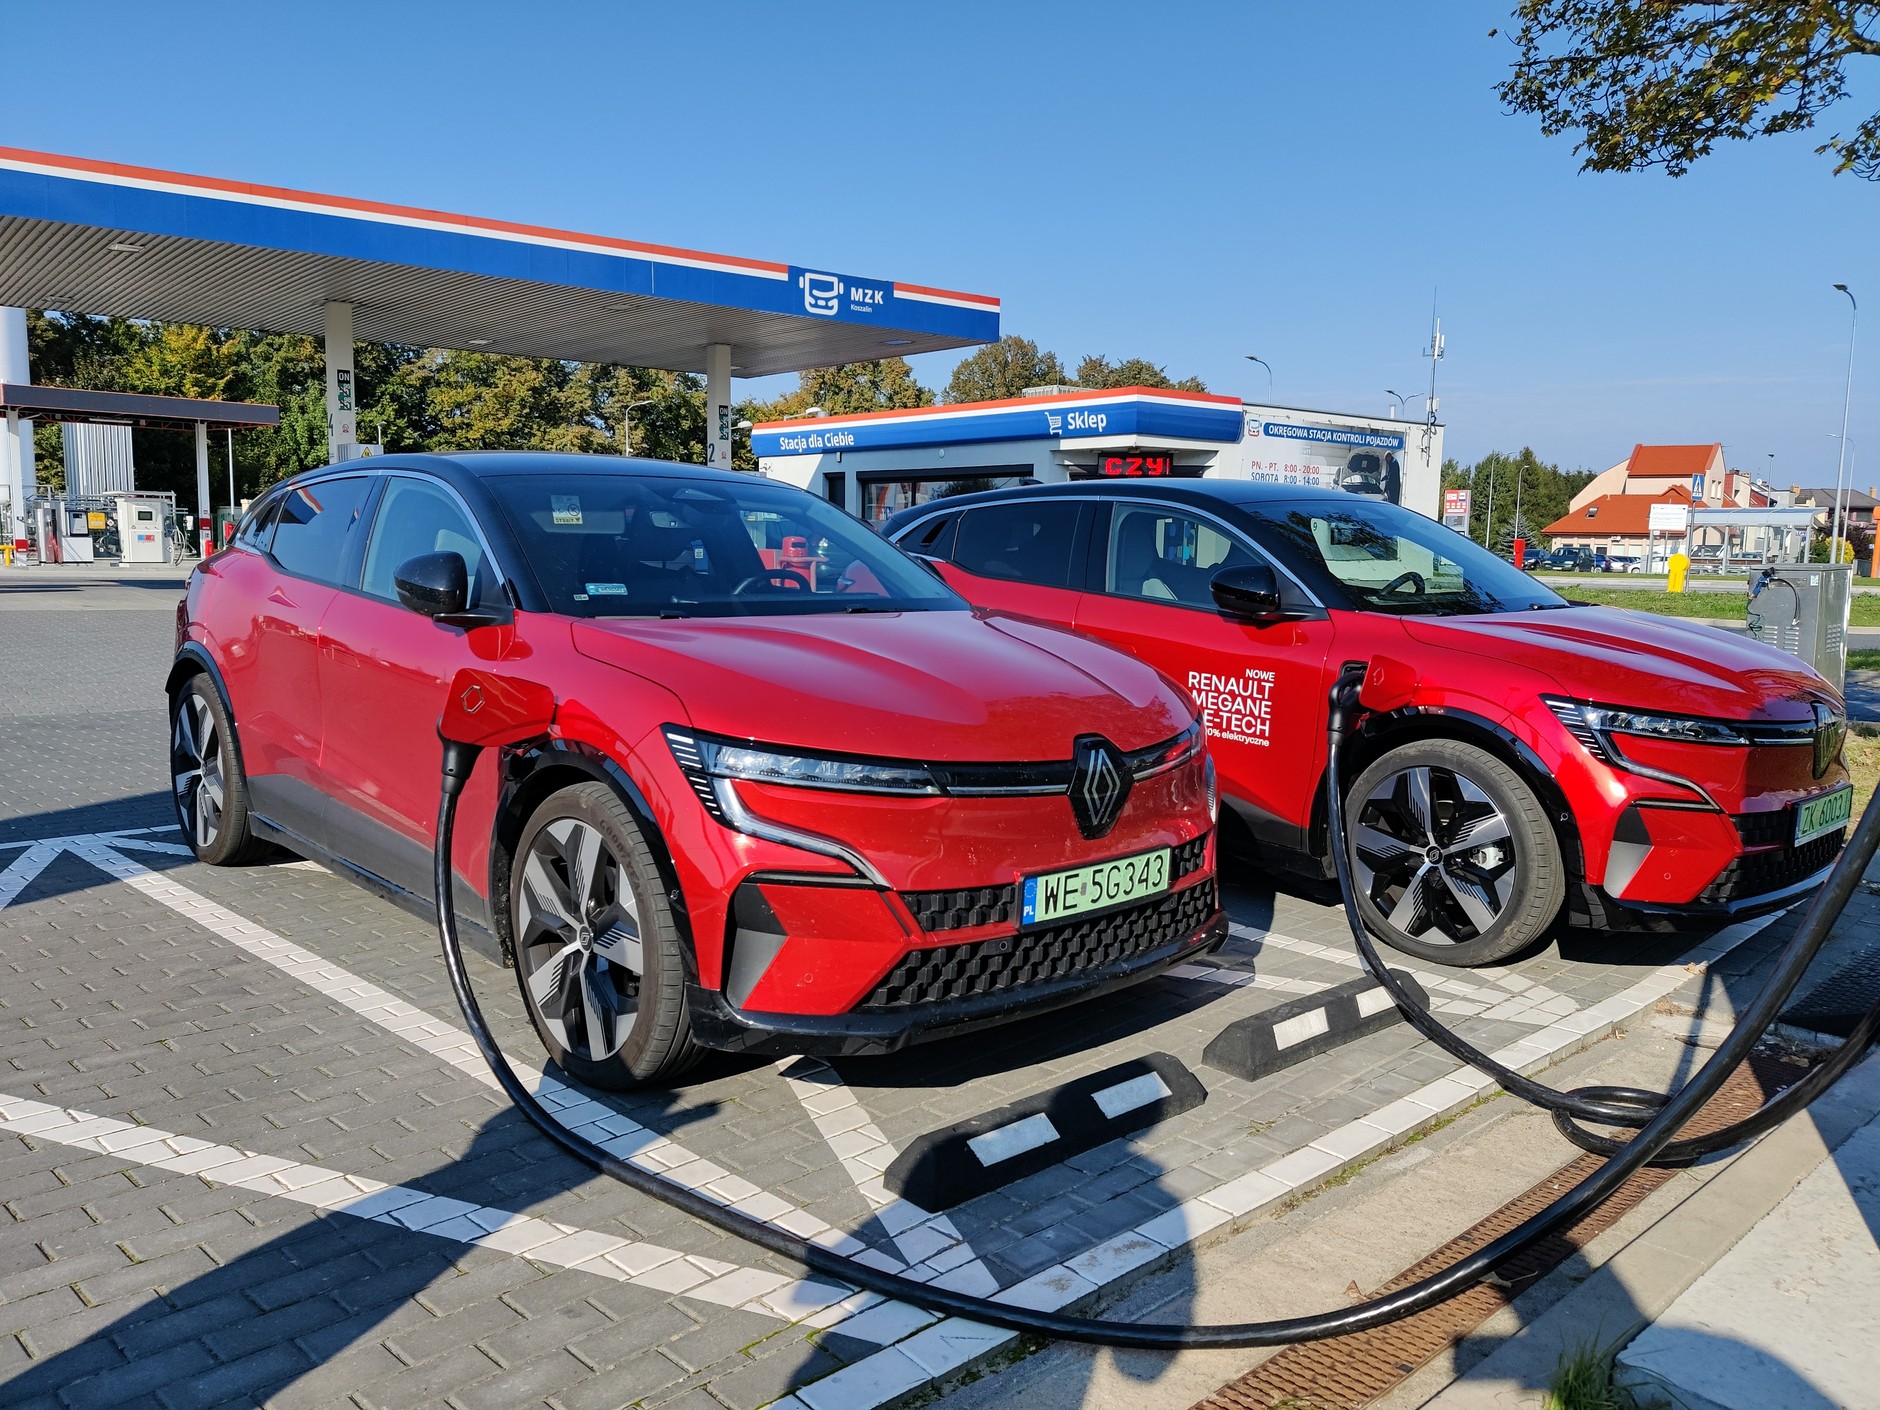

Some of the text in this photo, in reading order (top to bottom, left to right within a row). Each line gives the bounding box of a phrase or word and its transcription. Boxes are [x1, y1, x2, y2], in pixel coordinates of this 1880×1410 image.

[850, 286, 884, 305] MZK
[850, 303, 873, 313] Koszalin
[338, 372, 350, 381] ON
[719, 407, 728, 415] ON
[1067, 410, 1107, 432] Sklep
[779, 431, 855, 453] Stacja dla Ciebie
[1268, 424, 1400, 447] OKRĘGOWA STACJA KONTROLI POJAZDÓW
[708, 442, 716, 463] 2
[1105, 457, 1171, 476] CZY
[1251, 460, 1264, 470] PN.
[1268, 462, 1279, 472] PT.
[1283, 463, 1298, 473] 8:00
[1302, 465, 1320, 475] 20:00
[1188, 670, 1275, 700] RENAULT
[1245, 668, 1276, 682] NOWE
[1192, 689, 1273, 719] MEGANE
[1203, 709, 1270, 737] E-TECH
[1221, 730, 1270, 747] elektryczne
[1801, 802, 1818, 835] ZK
[1044, 854, 1164, 915] WE 5G343
[1023, 904, 1035, 917] PL
